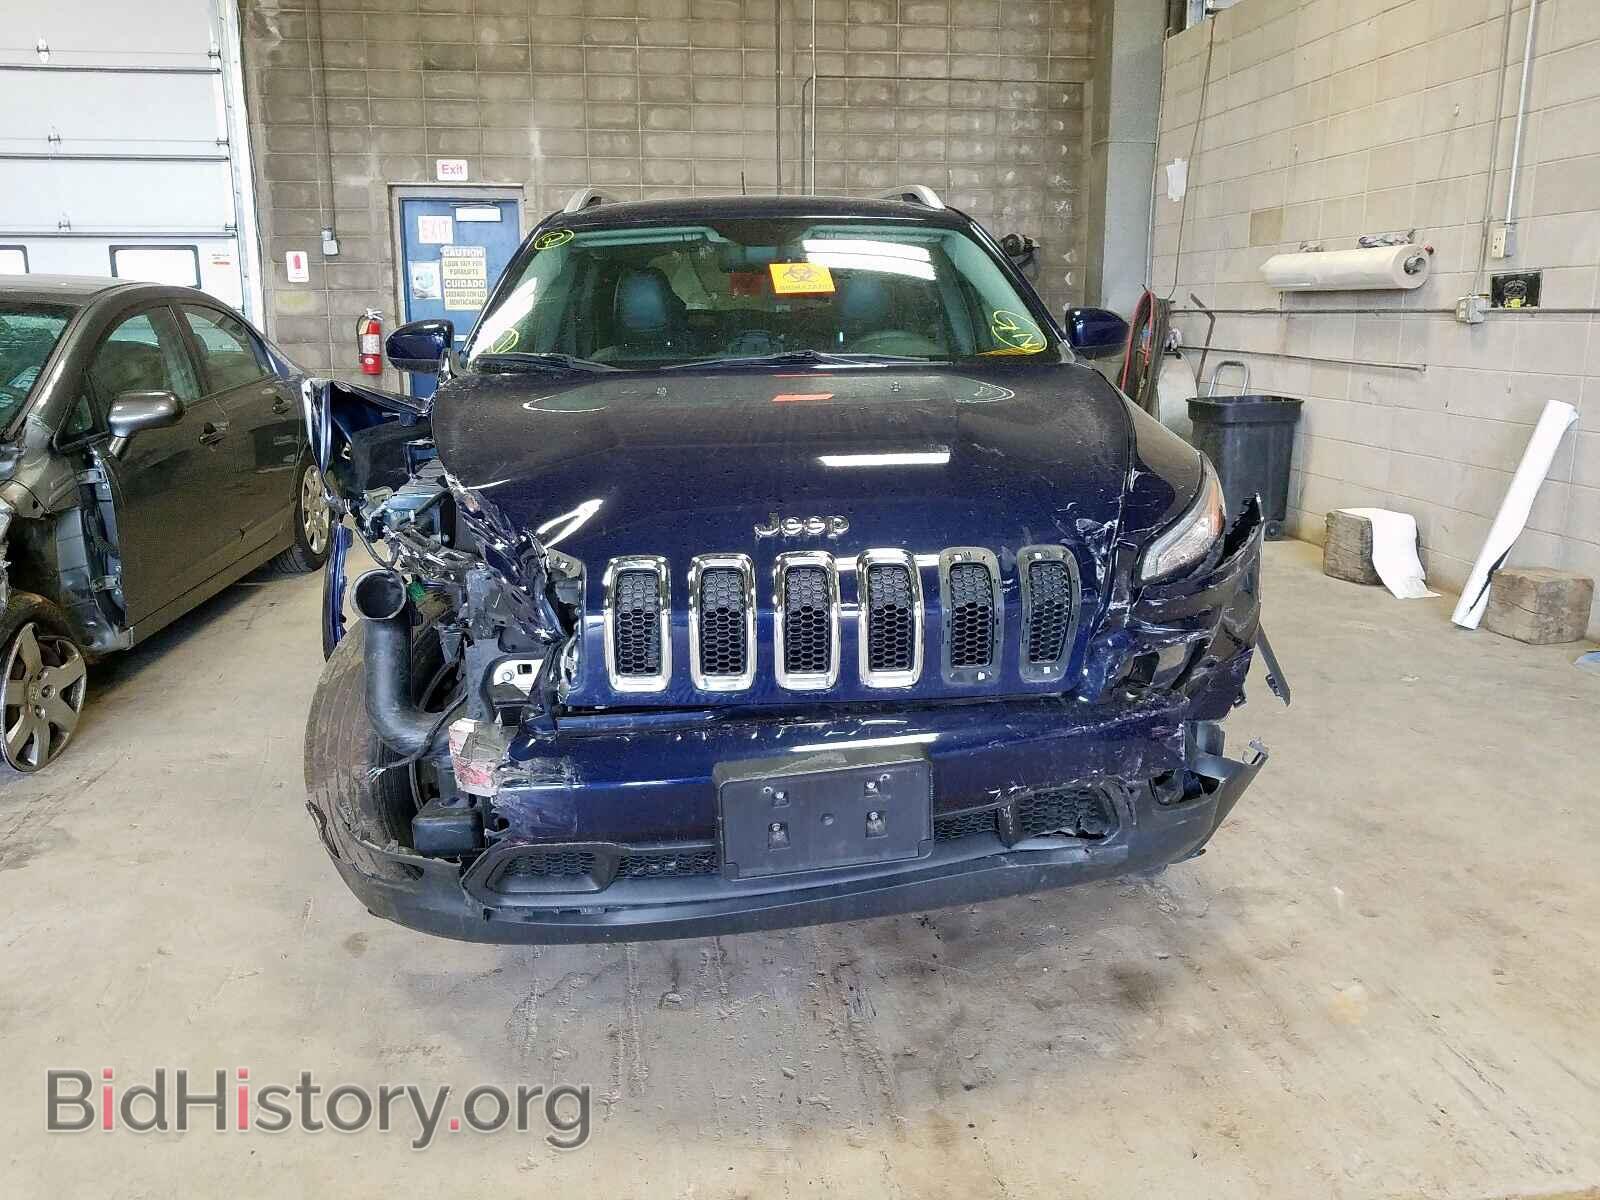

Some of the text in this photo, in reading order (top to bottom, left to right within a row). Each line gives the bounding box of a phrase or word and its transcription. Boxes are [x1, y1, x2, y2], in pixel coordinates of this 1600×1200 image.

[441, 164, 464, 175] Exit
[443, 247, 483, 257] CAUTION
[445, 279, 485, 288] CUIDADO
[754, 511, 850, 540] Jeep
